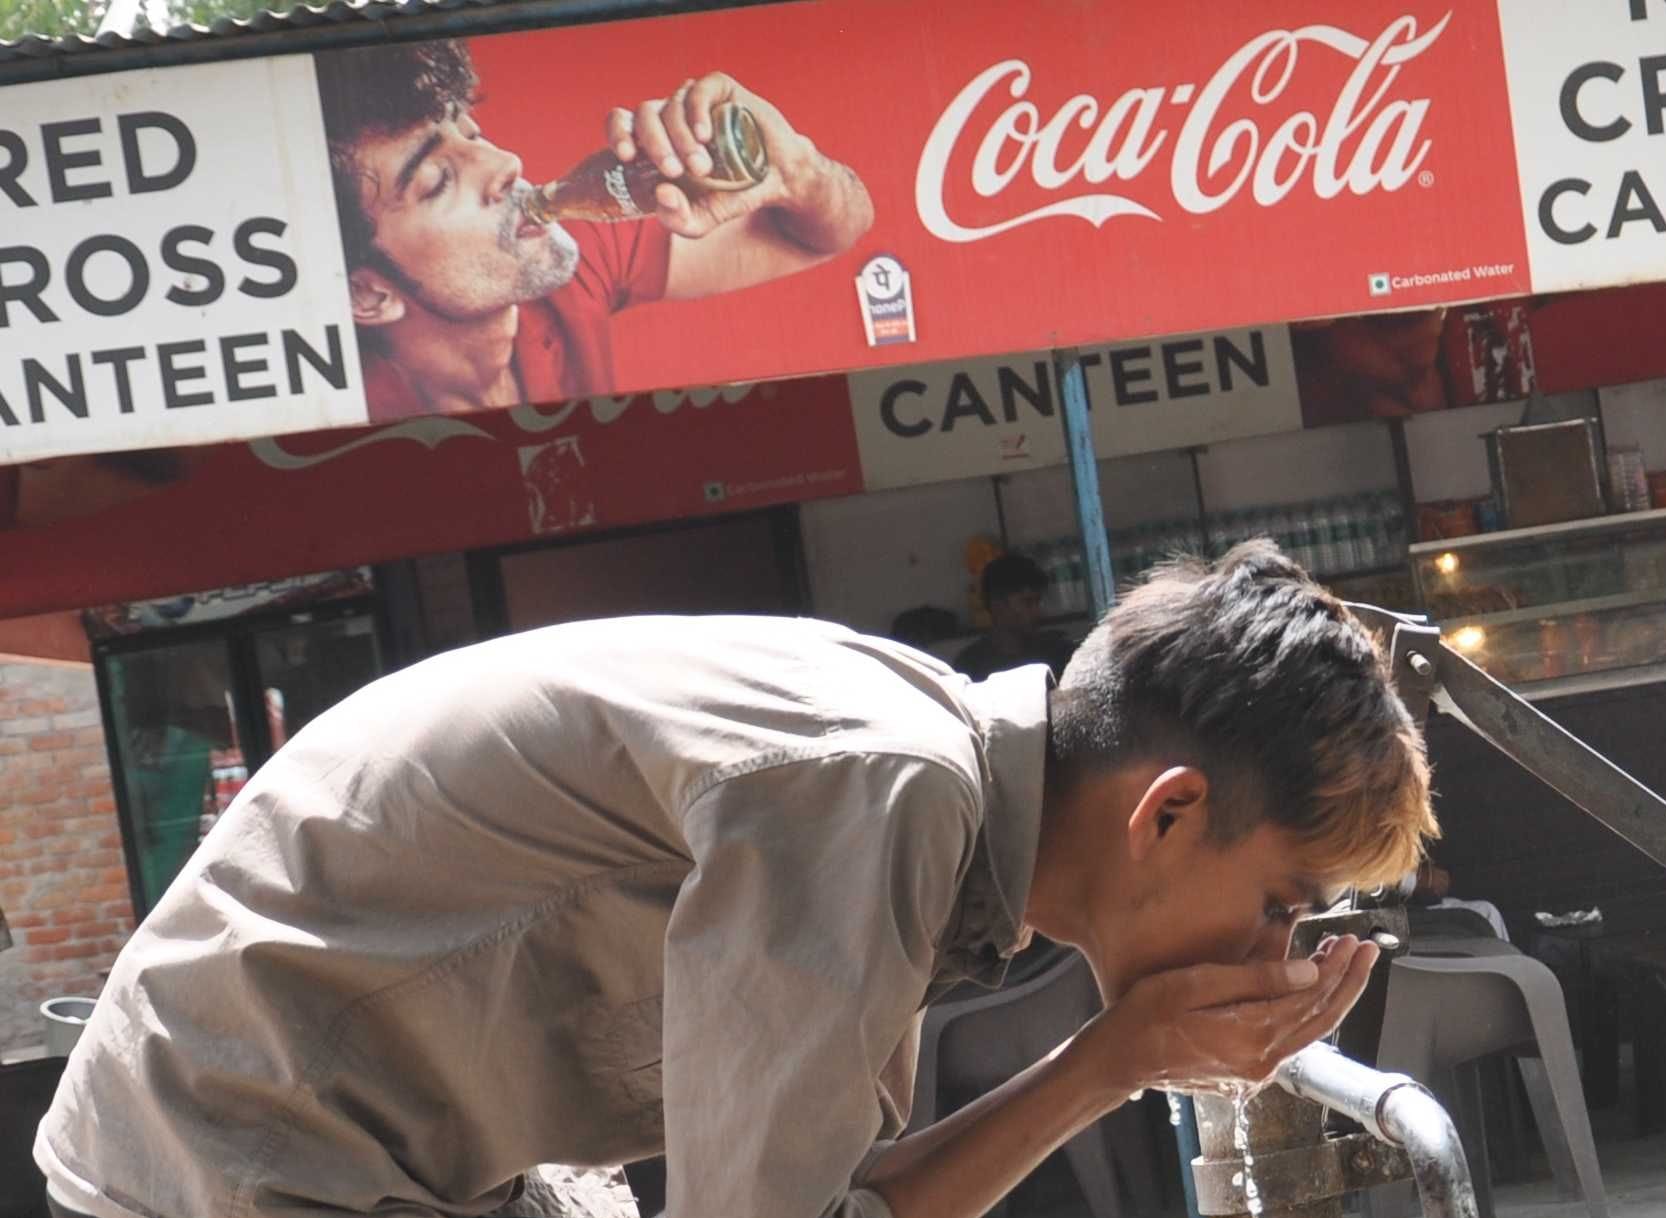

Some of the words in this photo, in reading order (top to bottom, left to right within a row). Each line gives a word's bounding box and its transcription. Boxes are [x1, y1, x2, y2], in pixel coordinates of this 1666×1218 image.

[915, 10, 1453, 243] Coca-Cola
[1391, 267, 1472, 289] Carbonated
[1474, 263, 1514, 279] Water
